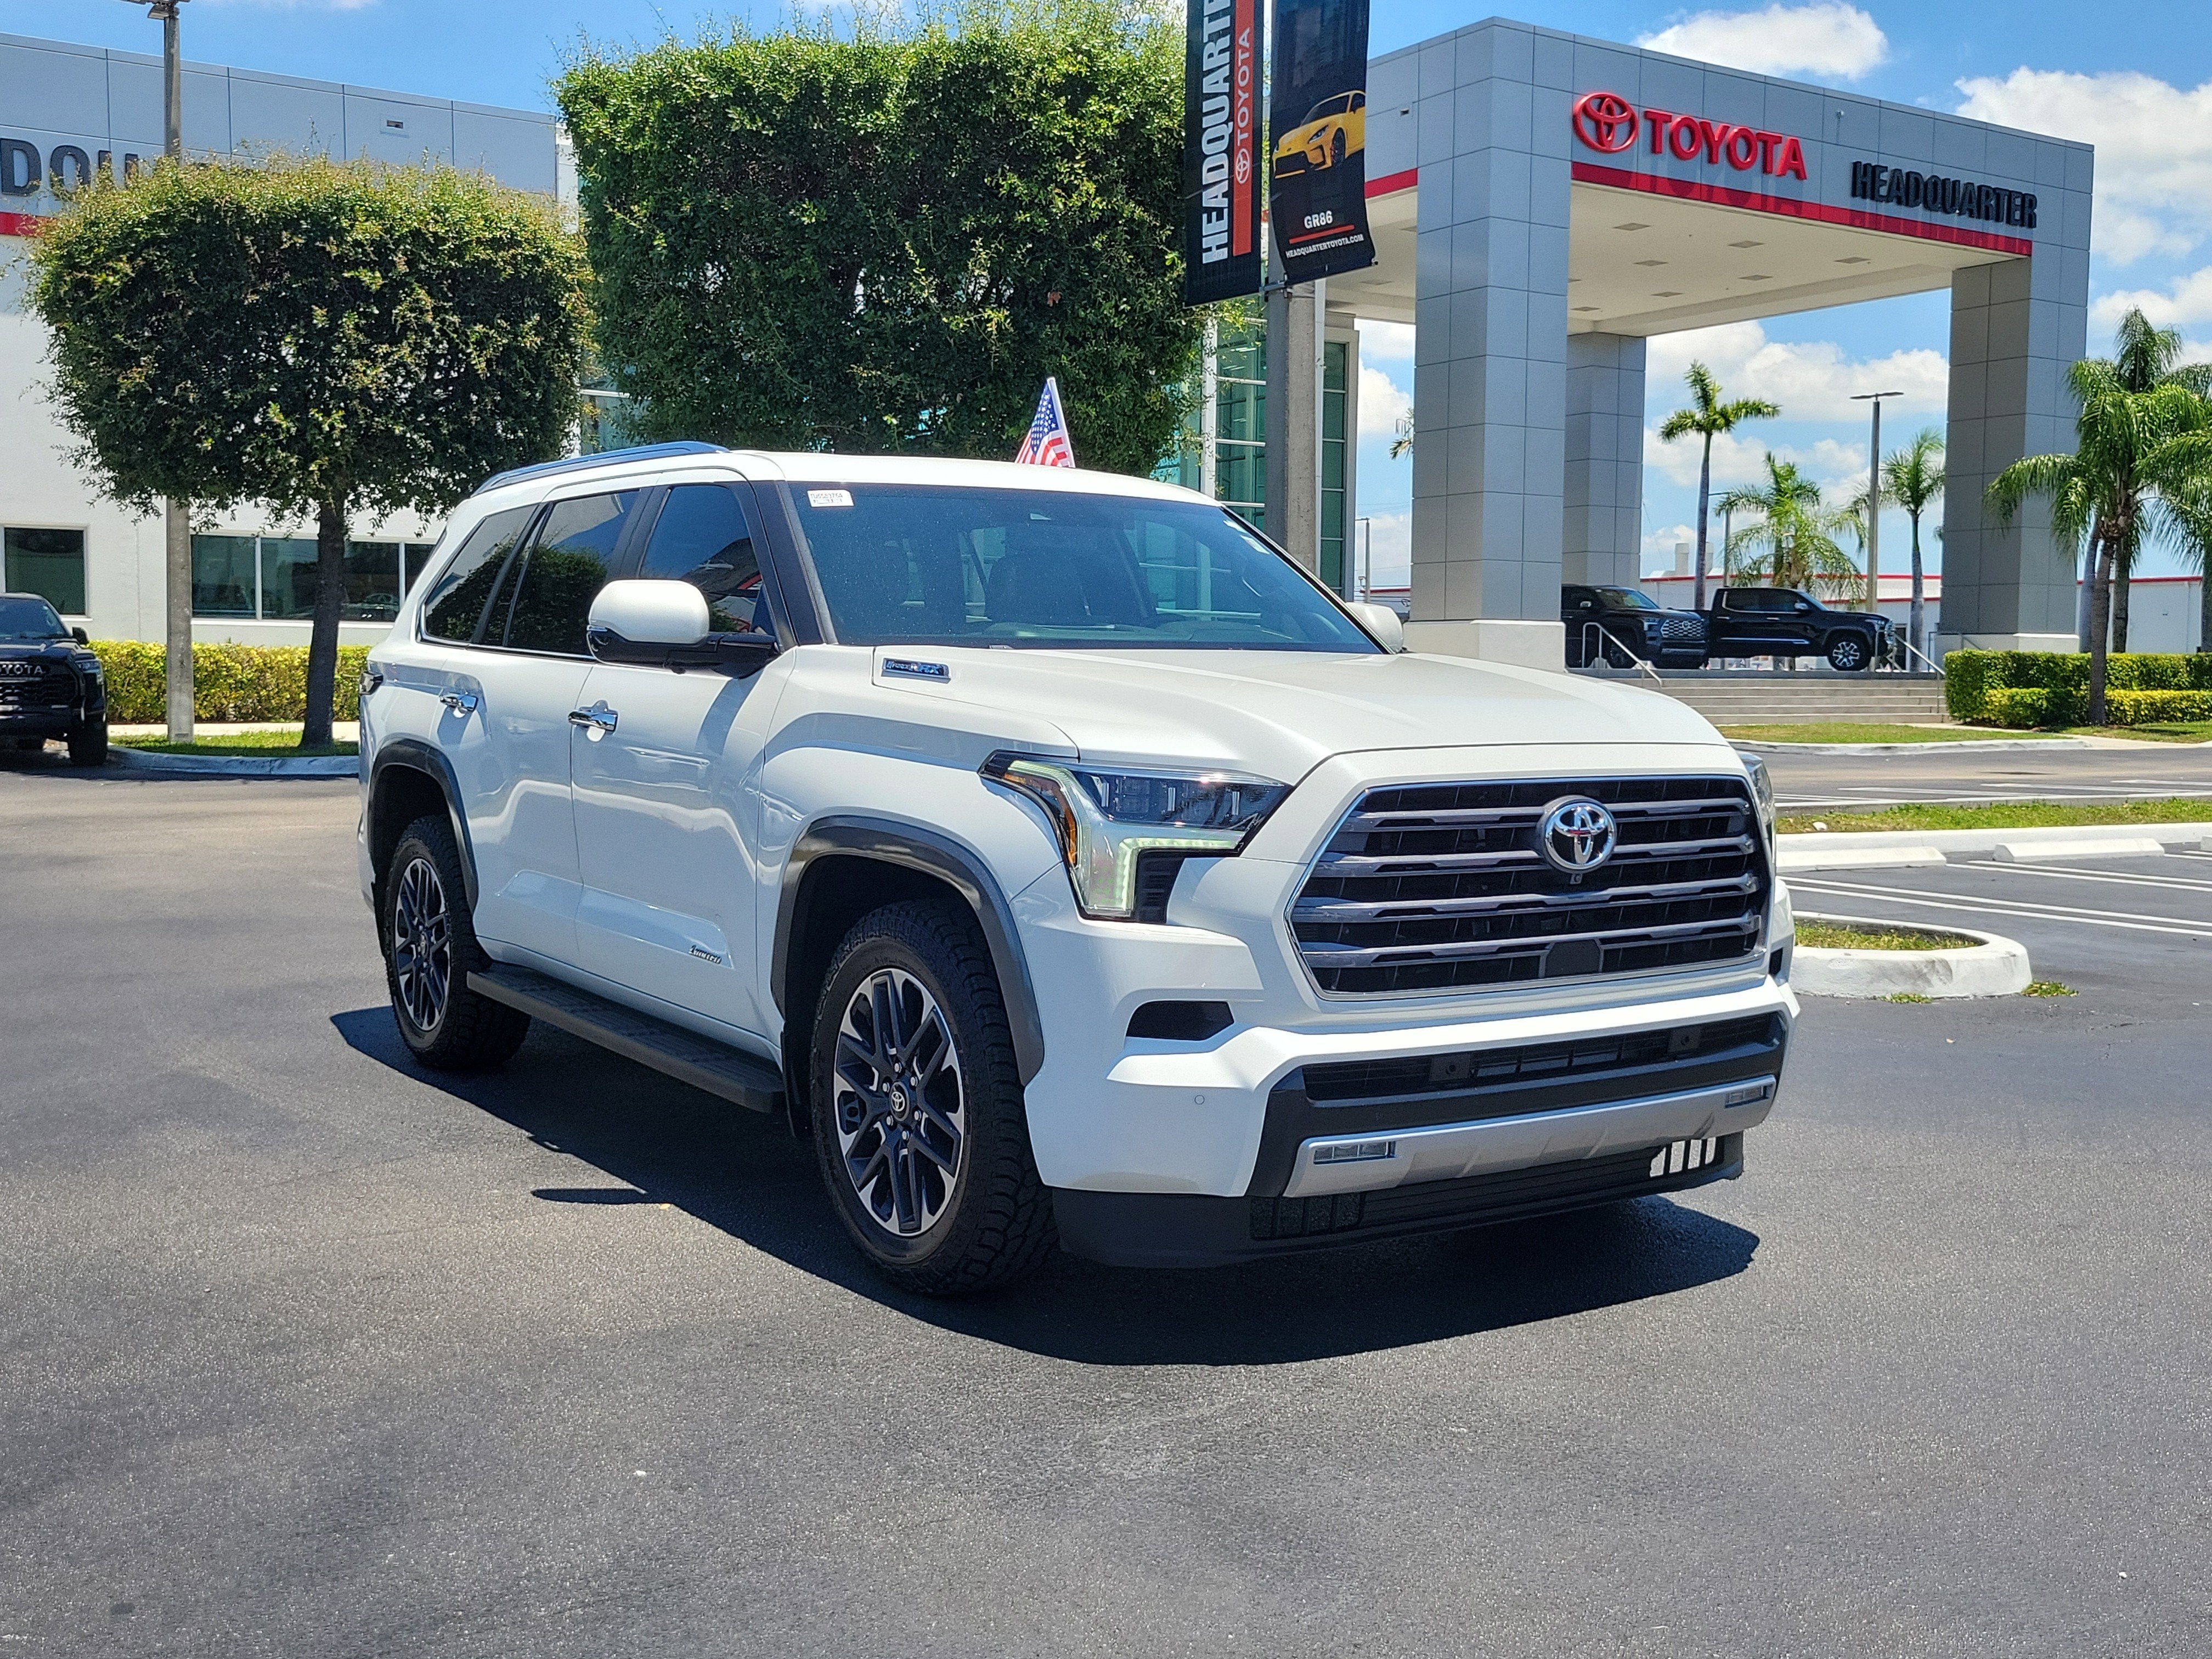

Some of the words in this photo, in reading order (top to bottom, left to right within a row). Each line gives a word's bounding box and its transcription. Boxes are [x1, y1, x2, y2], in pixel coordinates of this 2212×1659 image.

[1237, 27, 1251, 146] TOYOTA
[1643, 110, 1808, 181] TOYOTA
[1852, 160, 2038, 228] HEADQUARTER
[1304, 210, 1333, 229] GR86
[1285, 233, 1364, 258] HEADQUARTERTOYOTA.COM
[0, 664, 43, 675] YOTA
